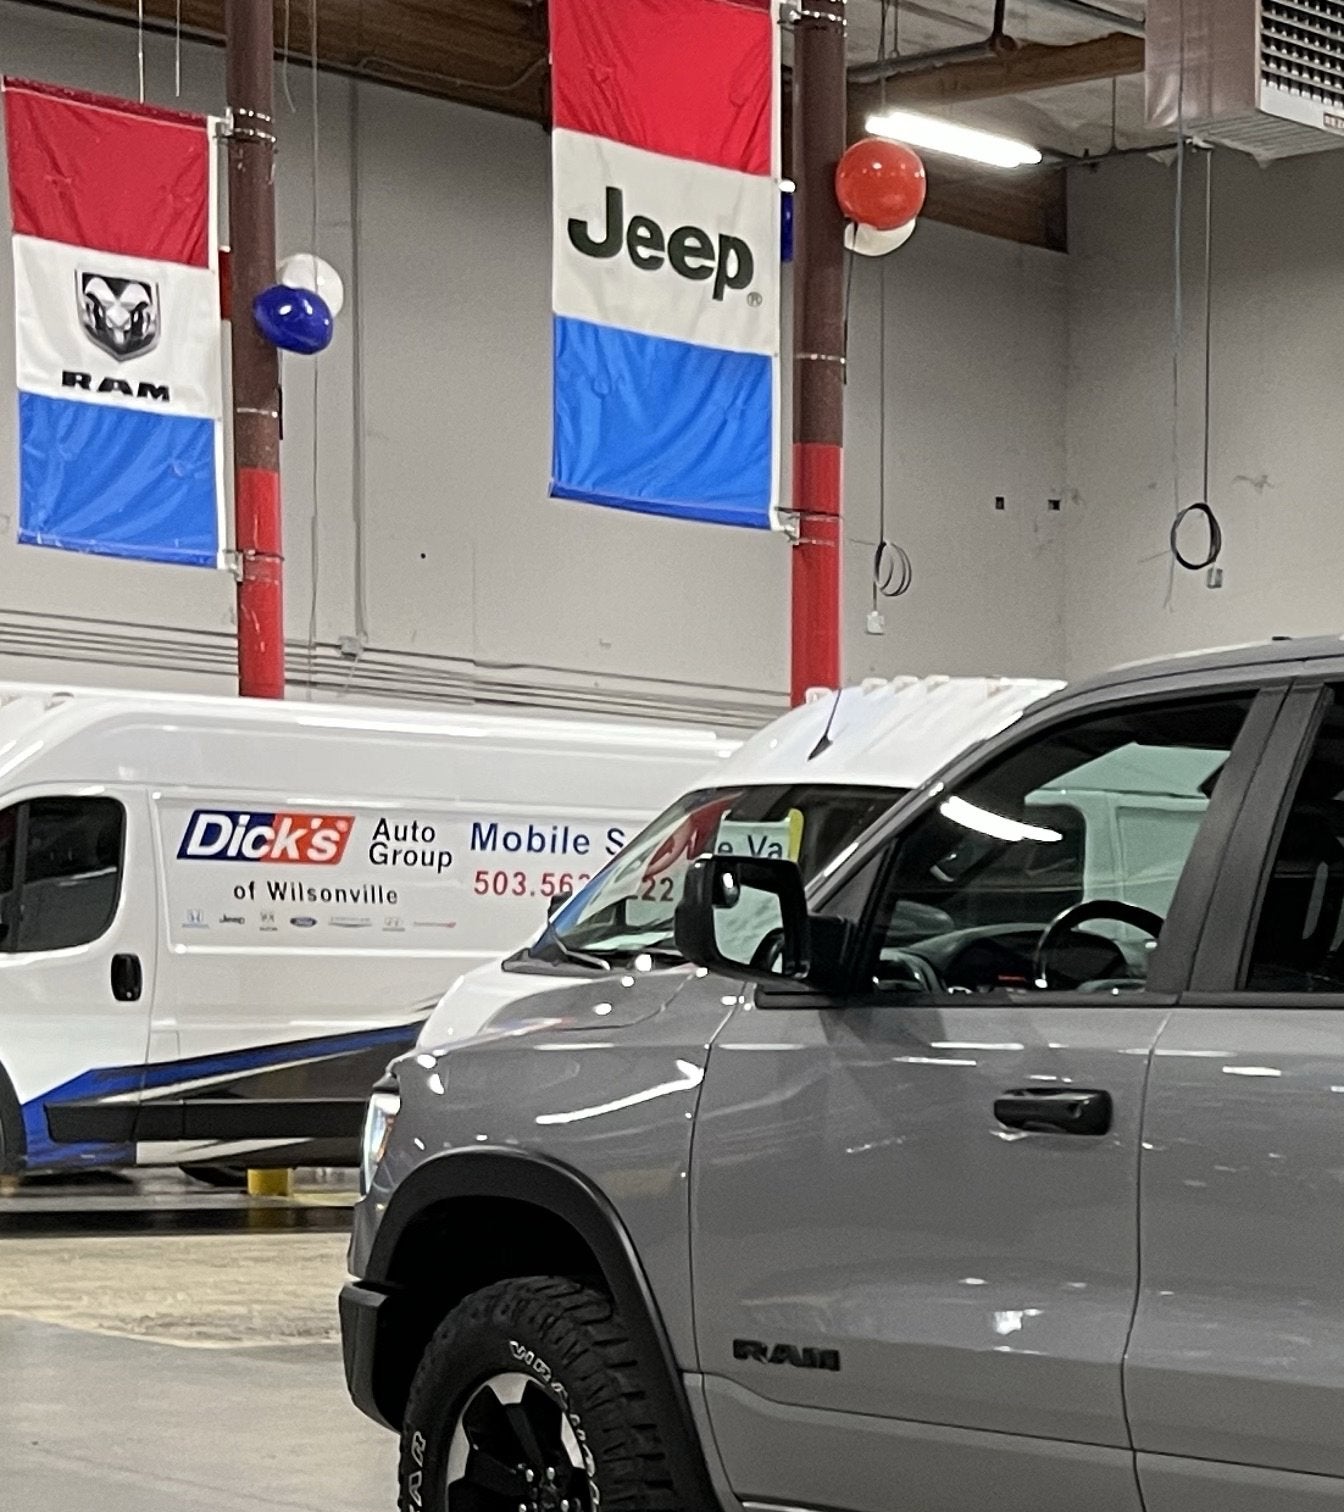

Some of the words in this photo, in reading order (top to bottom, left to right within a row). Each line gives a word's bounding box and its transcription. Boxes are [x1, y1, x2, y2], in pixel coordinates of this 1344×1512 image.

[567, 186, 755, 301] Jeep
[62, 370, 170, 402] RAM
[371, 818, 436, 843] Auto
[470, 822, 590, 855] Mobile
[369, 842, 453, 873] Group
[233, 881, 256, 901] of
[266, 881, 398, 905] Wilsonville
[733, 1339, 840, 1372] RAM
